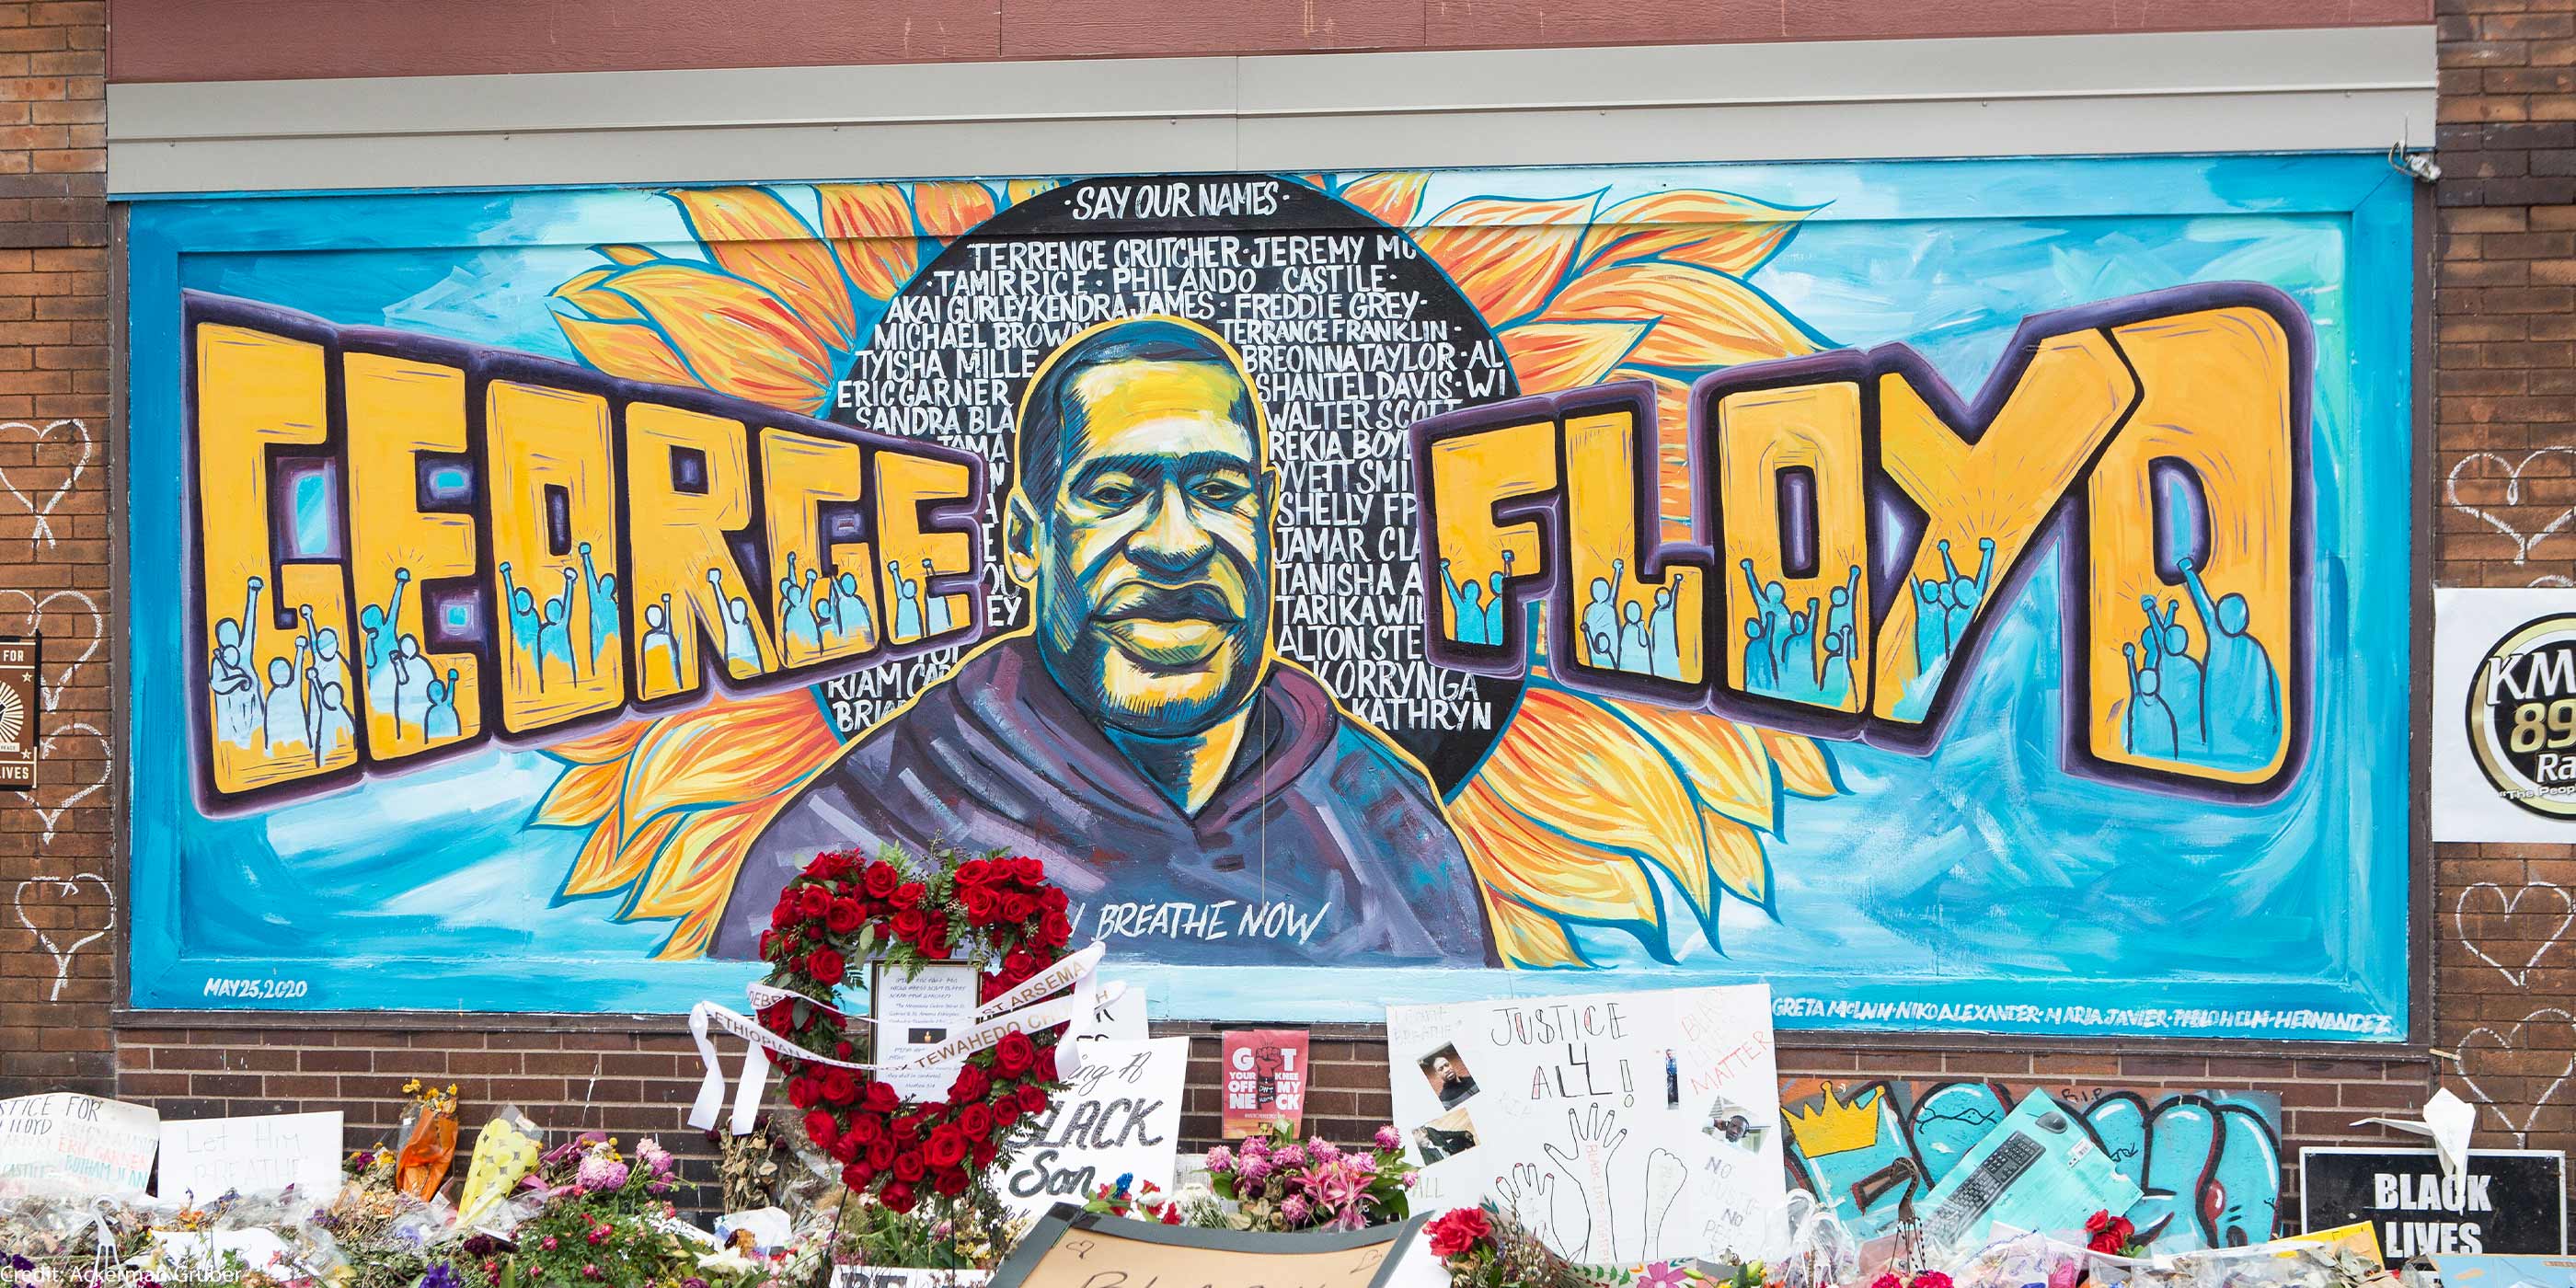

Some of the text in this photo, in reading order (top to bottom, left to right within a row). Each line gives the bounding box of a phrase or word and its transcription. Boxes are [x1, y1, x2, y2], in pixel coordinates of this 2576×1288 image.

[1072, 181, 1280, 220] SAY OUR NAMES
[967, 240, 1108, 271] TERRENCE
[1113, 236, 1242, 270] CRUTCHER
[1249, 235, 1365, 269] JEREMY
[933, 264, 1387, 297] TAMIR RICE PHILANDO CASTILE
[884, 290, 1421, 324] AKAI GURLEY KENDRA JAMES FREDDIE GREY
[874, 323, 988, 351] MICHAEL
[1217, 318, 1448, 345] TERRANCE FRANKLIN
[855, 349, 1040, 383] TYISHA MILLE
[1241, 339, 1505, 374] BREONNA TAYLOR AL
[837, 378, 1014, 409] ERIC GARNER
[1255, 369, 1507, 403] SHANTEL DAVIS WI
[855, 405, 1017, 436] SANDRA BLA
[1263, 400, 1373, 431] WALTER
[1268, 430, 1346, 461] REKIA
[1271, 458, 1355, 493] YVETT
[1276, 491, 1374, 527] SHELLY
[187, 313, 981, 802] GEORGE
[1272, 526, 1372, 564] JAMAR
[1422, 293, 2302, 795] FLOYD
[1274, 561, 1397, 596] TANISHA
[1275, 594, 1378, 627] TARIKA
[3, 650, 25, 662] FOR
[1275, 625, 1421, 661] ALTON STE
[1351, 696, 1492, 732] KATHRYN
[1091, 900, 1236, 941] BREATHE
[1237, 901, 1332, 945] NOW
[1010, 960, 1087, 1007] ARSEMA
[1490, 1001, 1629, 1047] JUSTICE
[1772, 997, 1825, 1018] GRETA
[1895, 1001, 1938, 1020] NIKO
[1937, 1003, 2040, 1024] ALEXANDER
[2103, 1008, 2169, 1028] JAVIER
[714, 1010, 802, 1059] ETHIOPIAN
[914, 1020, 1021, 1070] TEWAHEDO
[1228, 1071, 1299, 1081] YOUR KNEE
[1689, 1029, 1775, 1097] MATTER
[1227, 1080, 1257, 1093] OFF
[1276, 1081, 1301, 1094] MY
[1229, 1093, 1301, 1110] NE CK
[66, 1096, 104, 1121] FOR
[186, 1124, 231, 1153] Let
[1008, 1148, 1097, 1197] Son
[1704, 1156, 1732, 1179] NO
[1720, 1208, 1743, 1227] NO
[2386, 1221, 2483, 1259] LIVES
